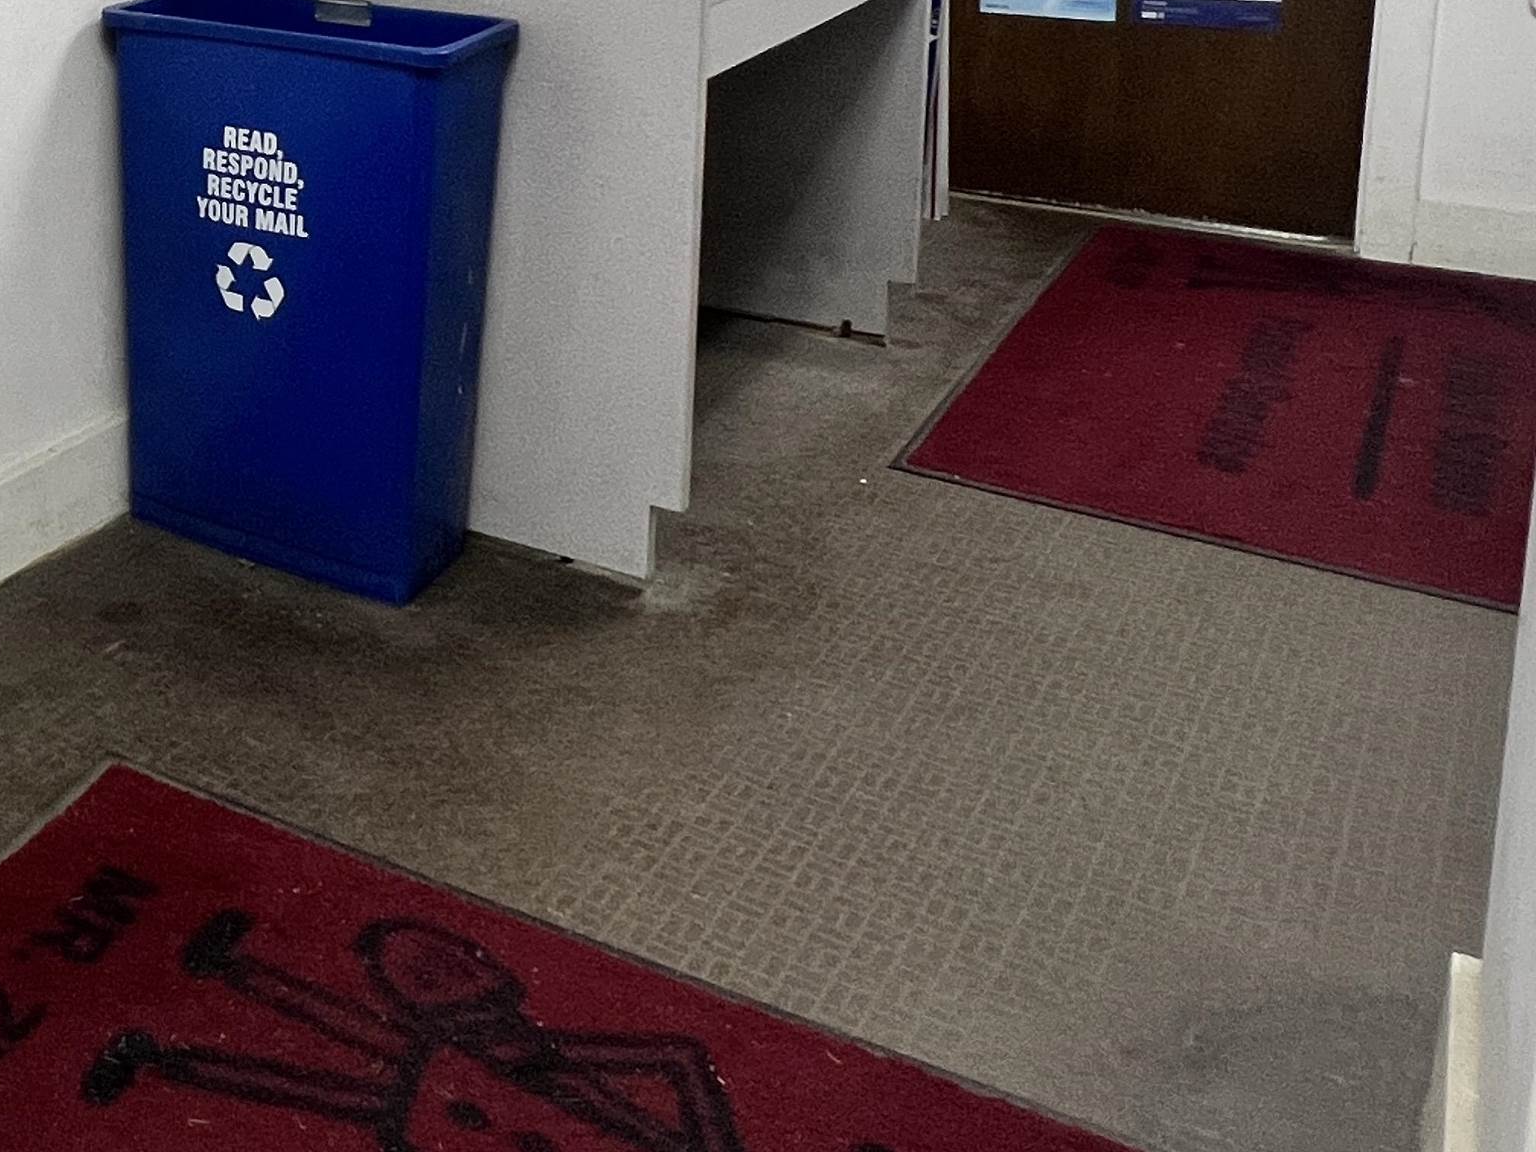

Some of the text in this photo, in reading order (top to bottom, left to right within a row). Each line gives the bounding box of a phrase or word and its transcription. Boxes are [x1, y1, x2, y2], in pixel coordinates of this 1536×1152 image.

[224, 125, 283, 160] READ,
[203, 147, 304, 189] RESPOND,
[207, 173, 298, 211] RECYCLE
[197, 195, 308, 238] YOUR MAIL
